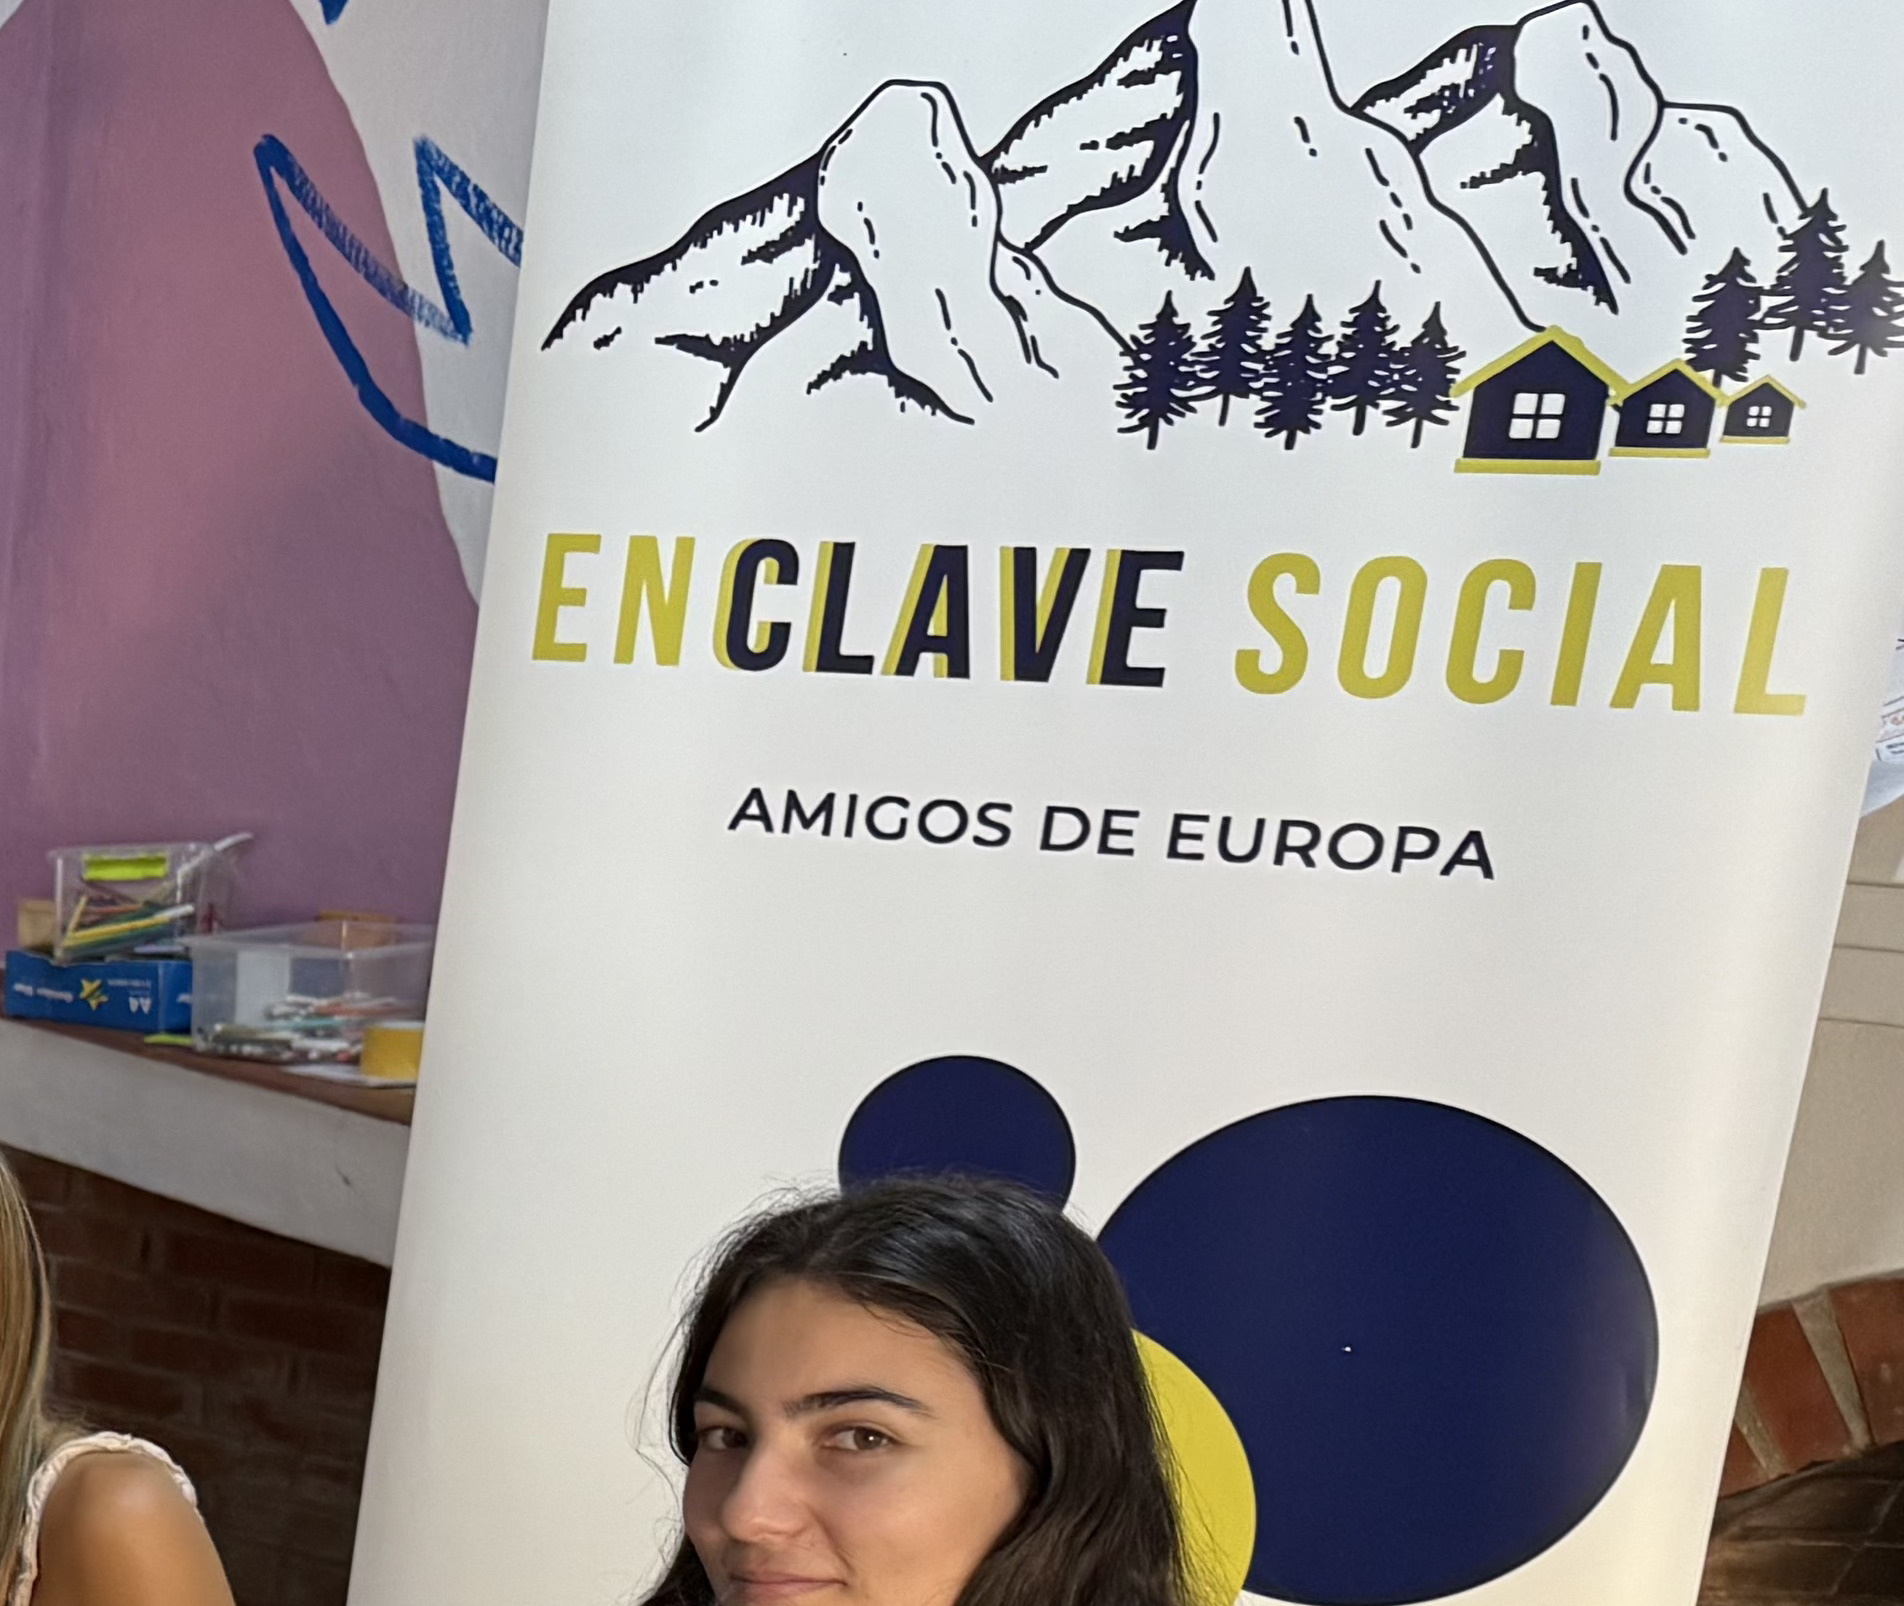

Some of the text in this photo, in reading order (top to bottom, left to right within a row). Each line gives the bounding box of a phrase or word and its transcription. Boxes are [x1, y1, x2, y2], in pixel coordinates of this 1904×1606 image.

[531, 532, 1808, 717] ENCLAVE SOCIAL
[728, 787, 1495, 881] AMIGOS DE EUROPA
